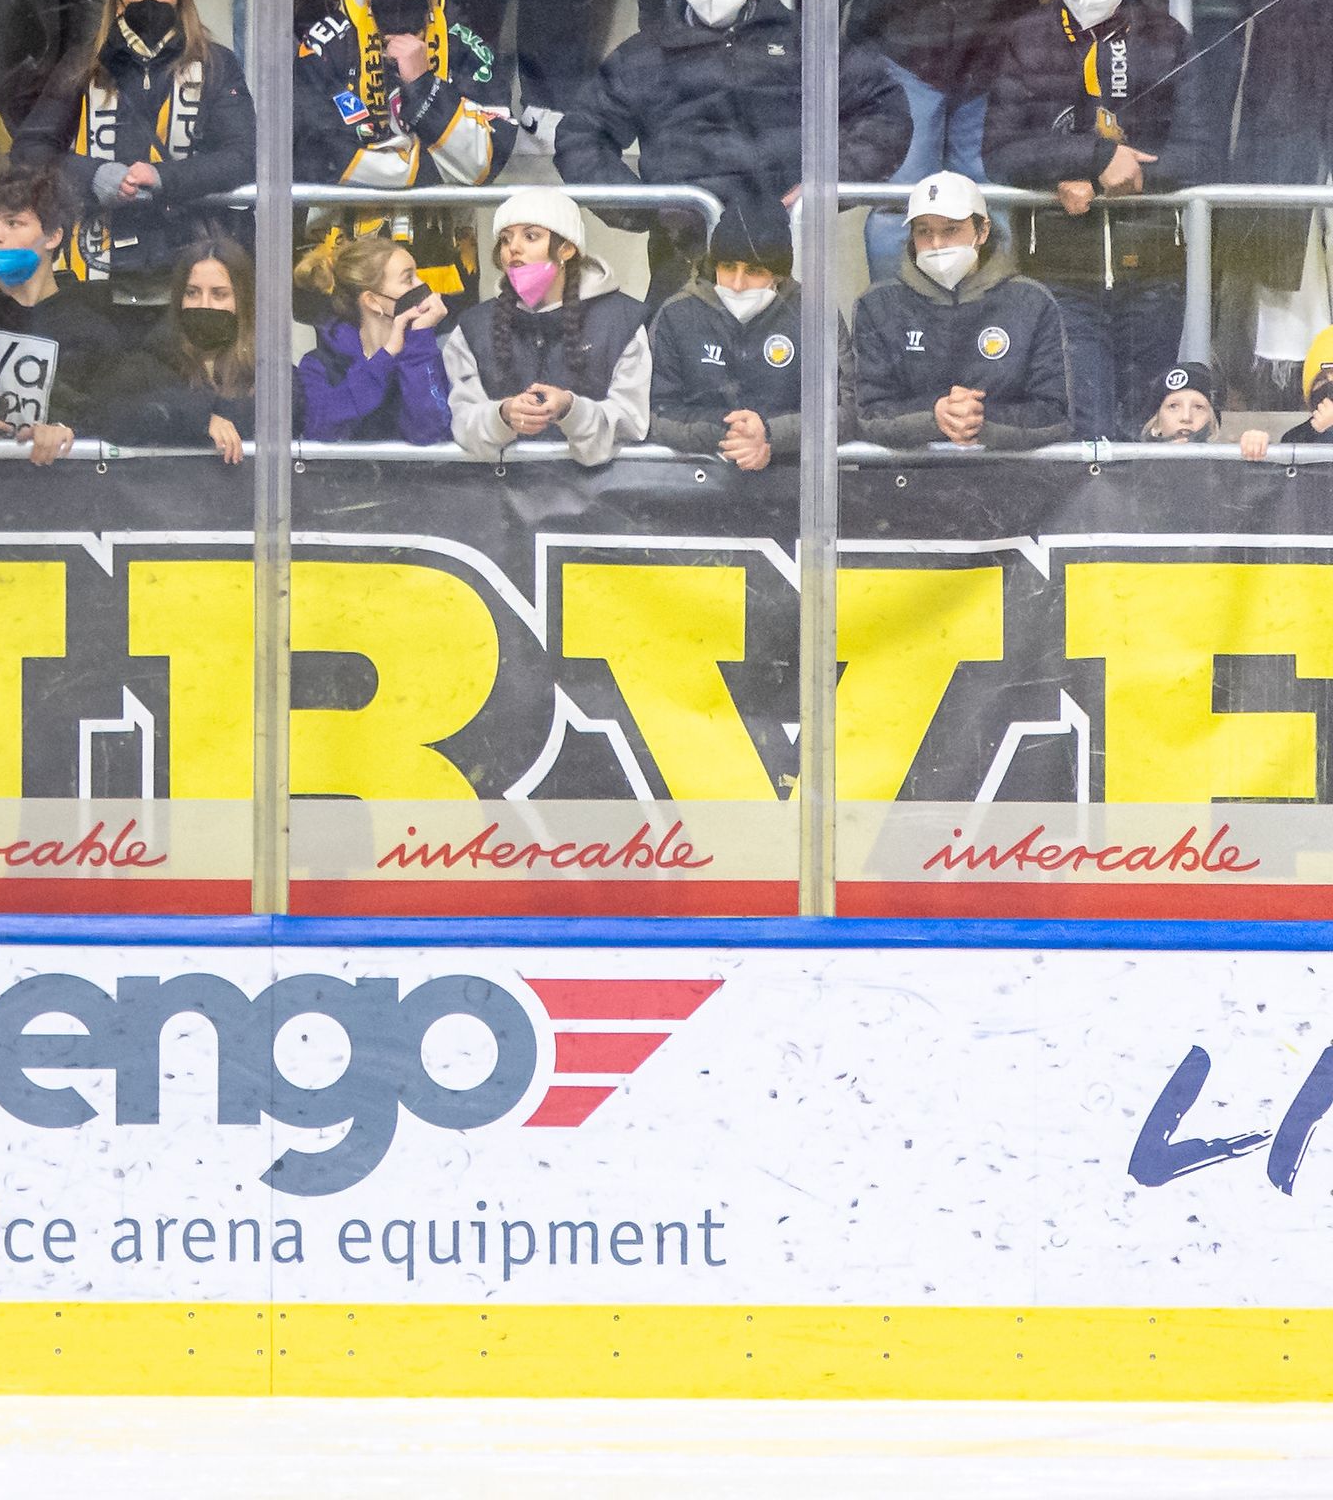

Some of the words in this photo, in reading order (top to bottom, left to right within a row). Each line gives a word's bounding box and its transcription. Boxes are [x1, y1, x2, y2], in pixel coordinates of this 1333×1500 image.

[376, 820, 715, 873] intercable
[922, 822, 1261, 874] intercable
[111, 1211, 306, 1265] arena
[337, 1199, 727, 1282] equipment
